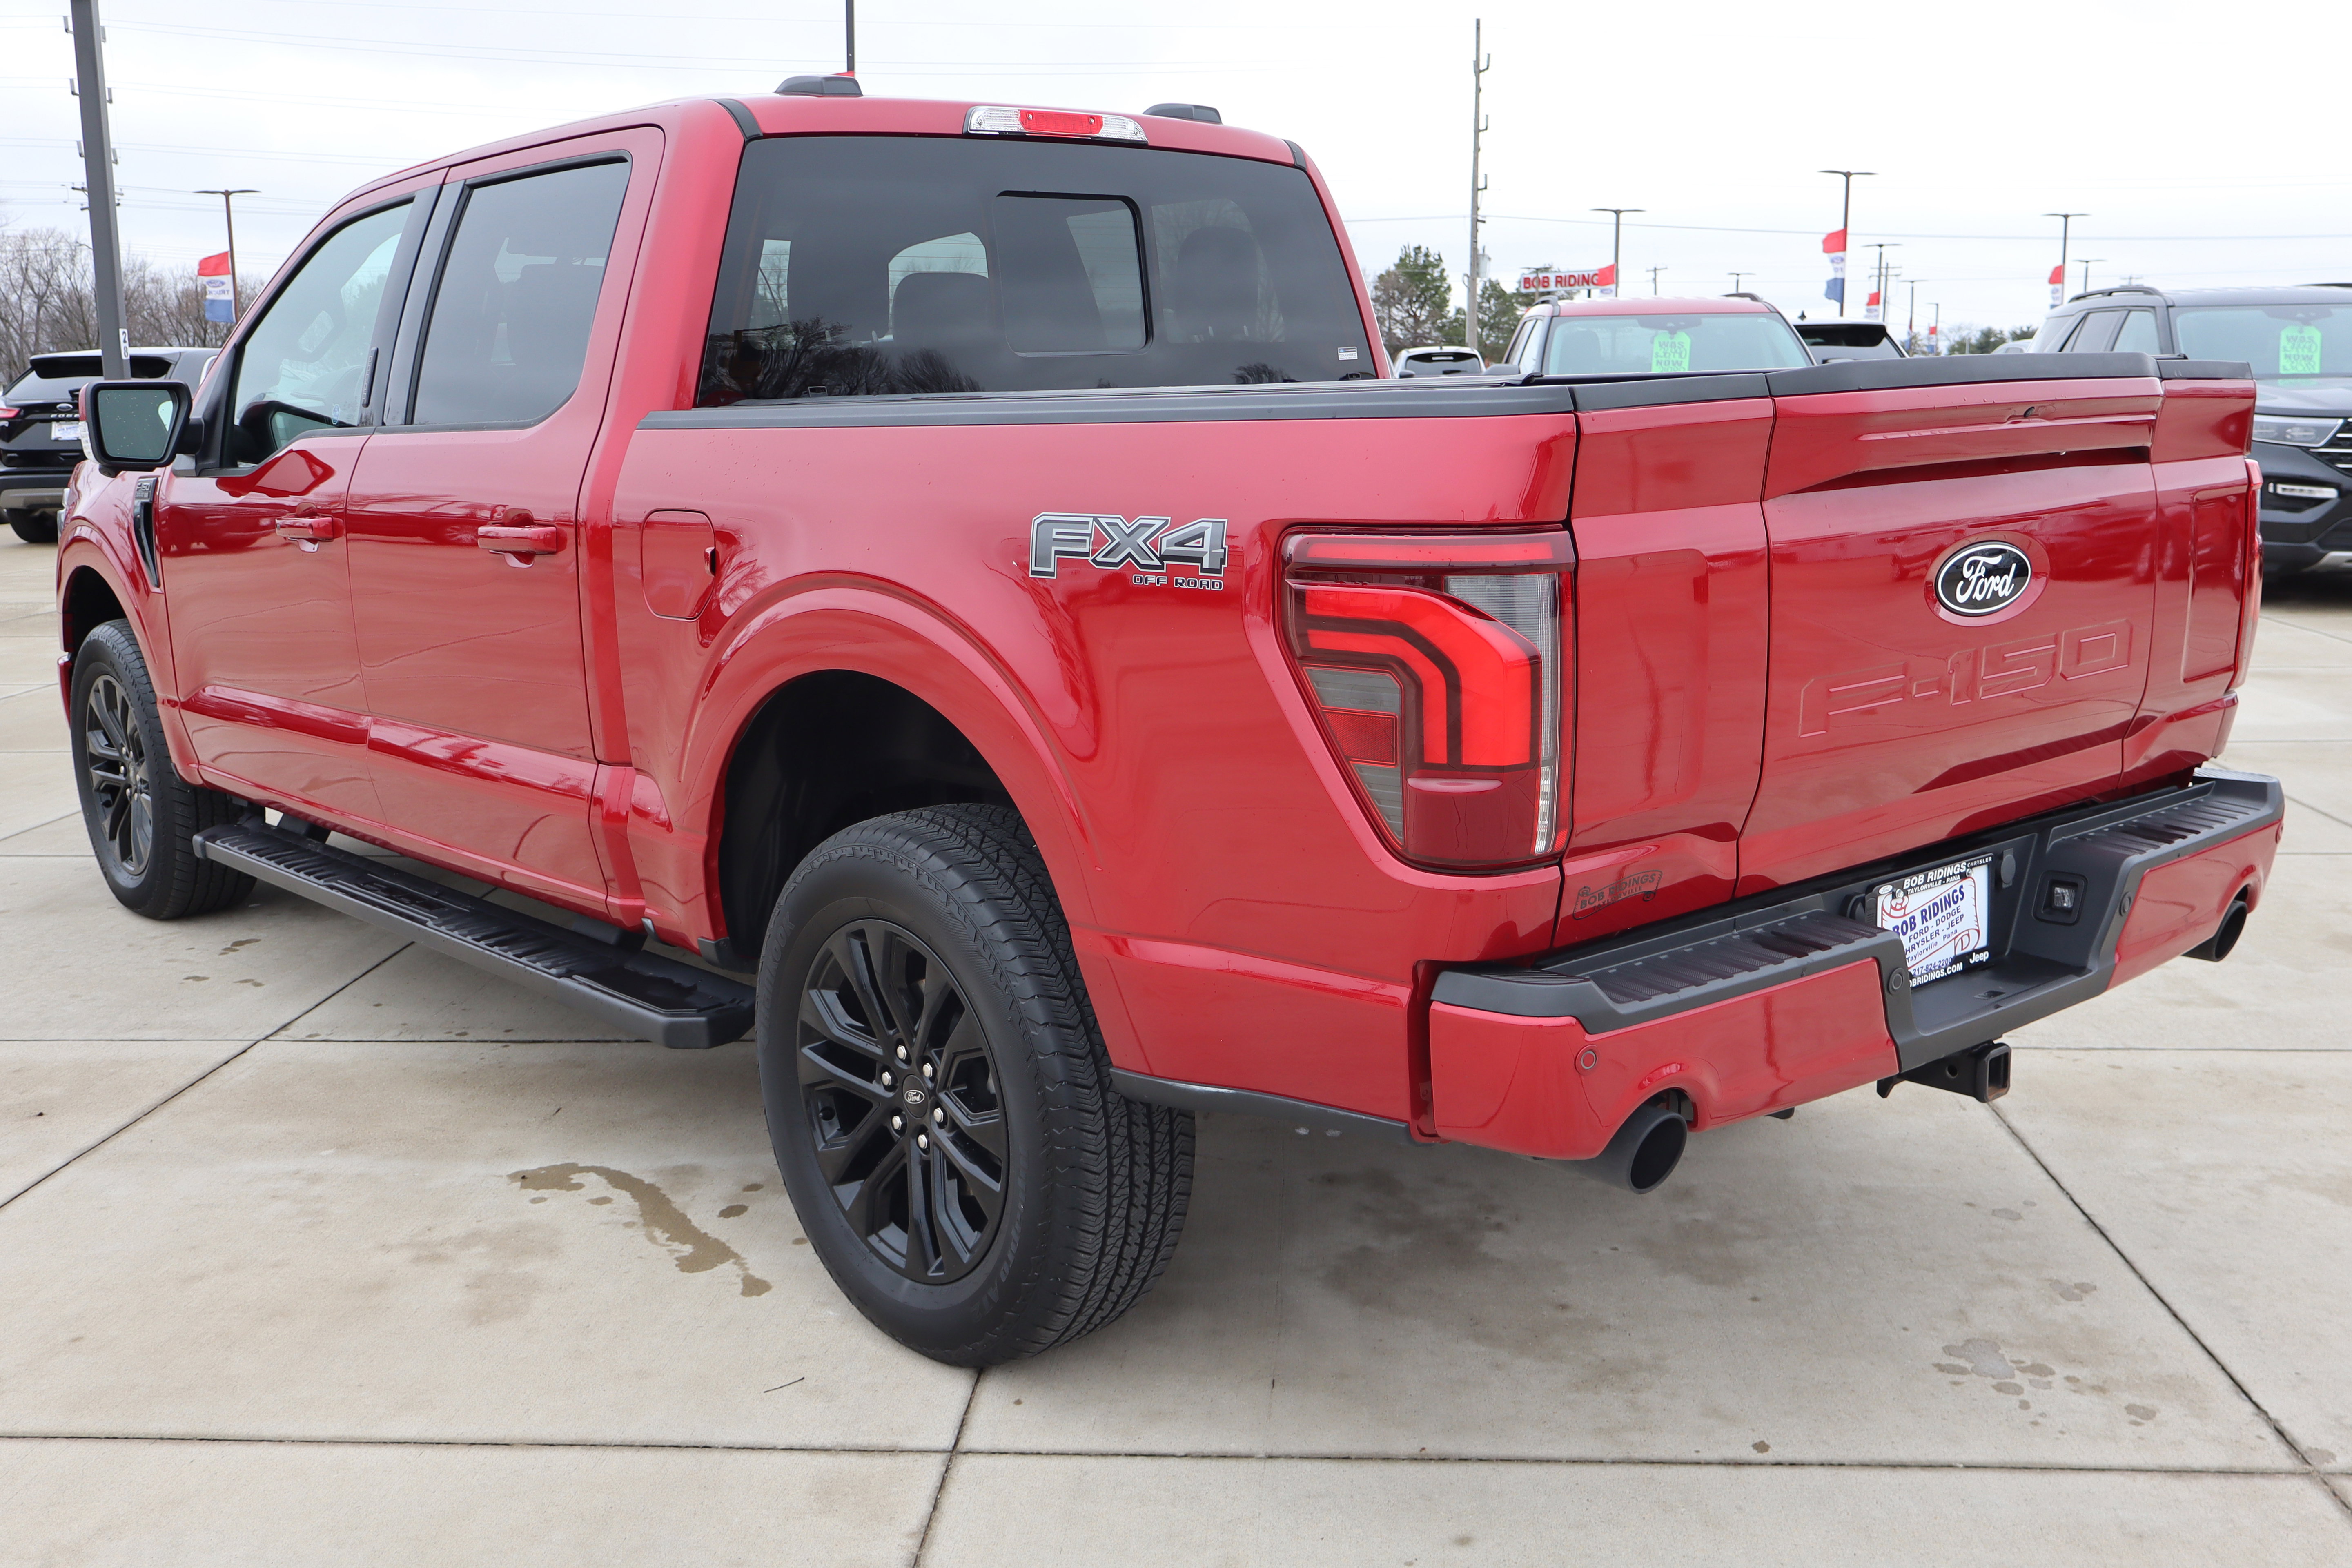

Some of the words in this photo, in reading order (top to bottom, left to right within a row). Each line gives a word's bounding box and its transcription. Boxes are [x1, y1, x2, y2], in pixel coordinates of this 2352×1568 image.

[1523, 276, 1550, 289] BOB
[1555, 273, 1599, 287] RIDING
[1029, 512, 1228, 579] FX4
[1132, 574, 1168, 587] OFF
[1174, 577, 1223, 591] ROAD
[1956, 555, 2017, 603] Ford
[1800, 618, 2133, 737] F-150
[1903, 874, 1924, 889] BOB
[1927, 862, 1967, 882] RIDINGS
[1967, 856, 1992, 868] CHRYSLER
[1580, 891, 1605, 909] BOB
[1609, 873, 1656, 895] RIDINGS
[1907, 879, 1942, 895] TAYLORVILLE
[1946, 874, 1960, 884] PANA
[1893, 915, 1916, 936] BOB
[1920, 884, 1965, 925] RIDINGS
[1905, 929, 1940, 956] HRYSLER
[1947, 914, 1964, 930] JEEP
[1909, 926, 1929, 943] FORD
[1936, 905, 1961, 927] DODGE
[1907, 941, 1938, 963] Taylorville
[1943, 929, 1958, 941] Pana
[1969, 951, 1989, 964] Jeep
[1909, 962, 1963, 987] BRIDINGS.COM
[1913, 957, 1953, 976] 217-824-2200
[908, 1091, 921, 1102] Ford
